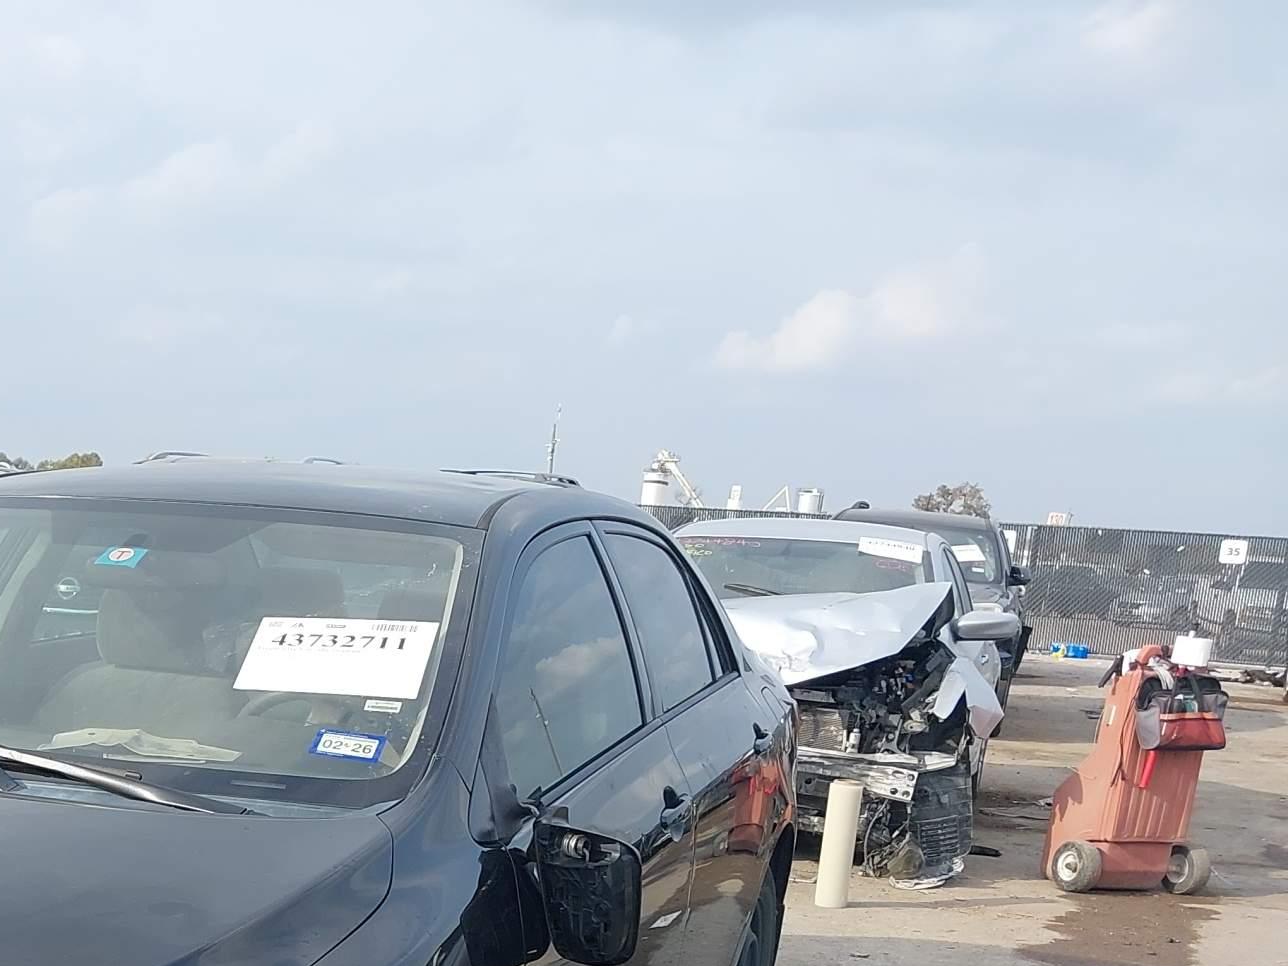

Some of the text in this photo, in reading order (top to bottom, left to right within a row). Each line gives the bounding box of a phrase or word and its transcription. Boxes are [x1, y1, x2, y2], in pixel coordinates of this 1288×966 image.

[116, 550, 132, 560] T
[1225, 547, 1241, 556] 35
[271, 633, 407, 650] 43732711
